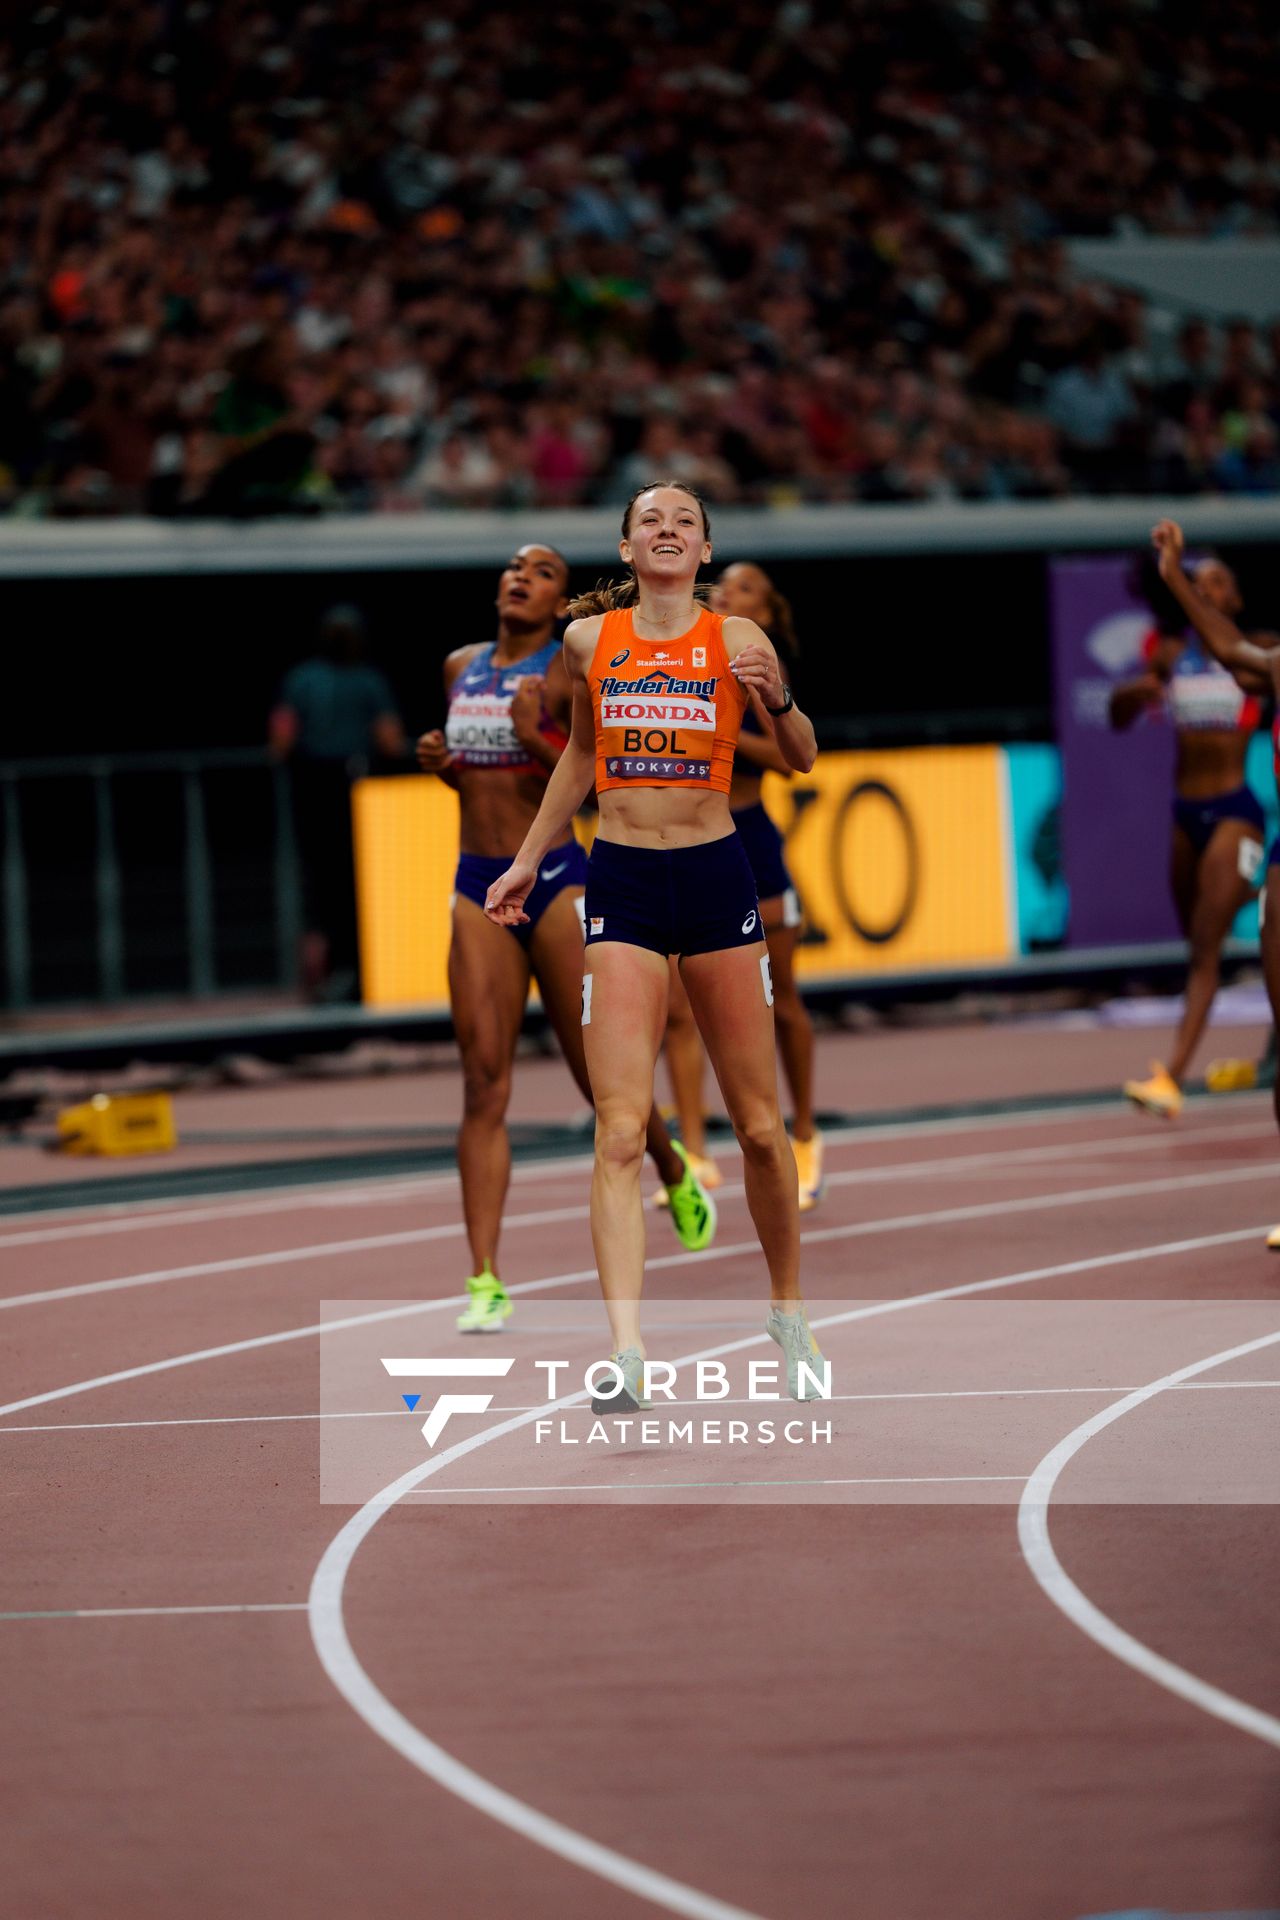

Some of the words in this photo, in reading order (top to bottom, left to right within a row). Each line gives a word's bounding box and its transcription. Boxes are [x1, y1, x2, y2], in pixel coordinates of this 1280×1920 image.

[635, 658, 684, 667] Staatsloterij
[599, 677, 717, 696] Nederland
[603, 704, 713, 723] HONDA
[623, 729, 687, 754] BOL
[624, 762, 685, 774] TOKYO
